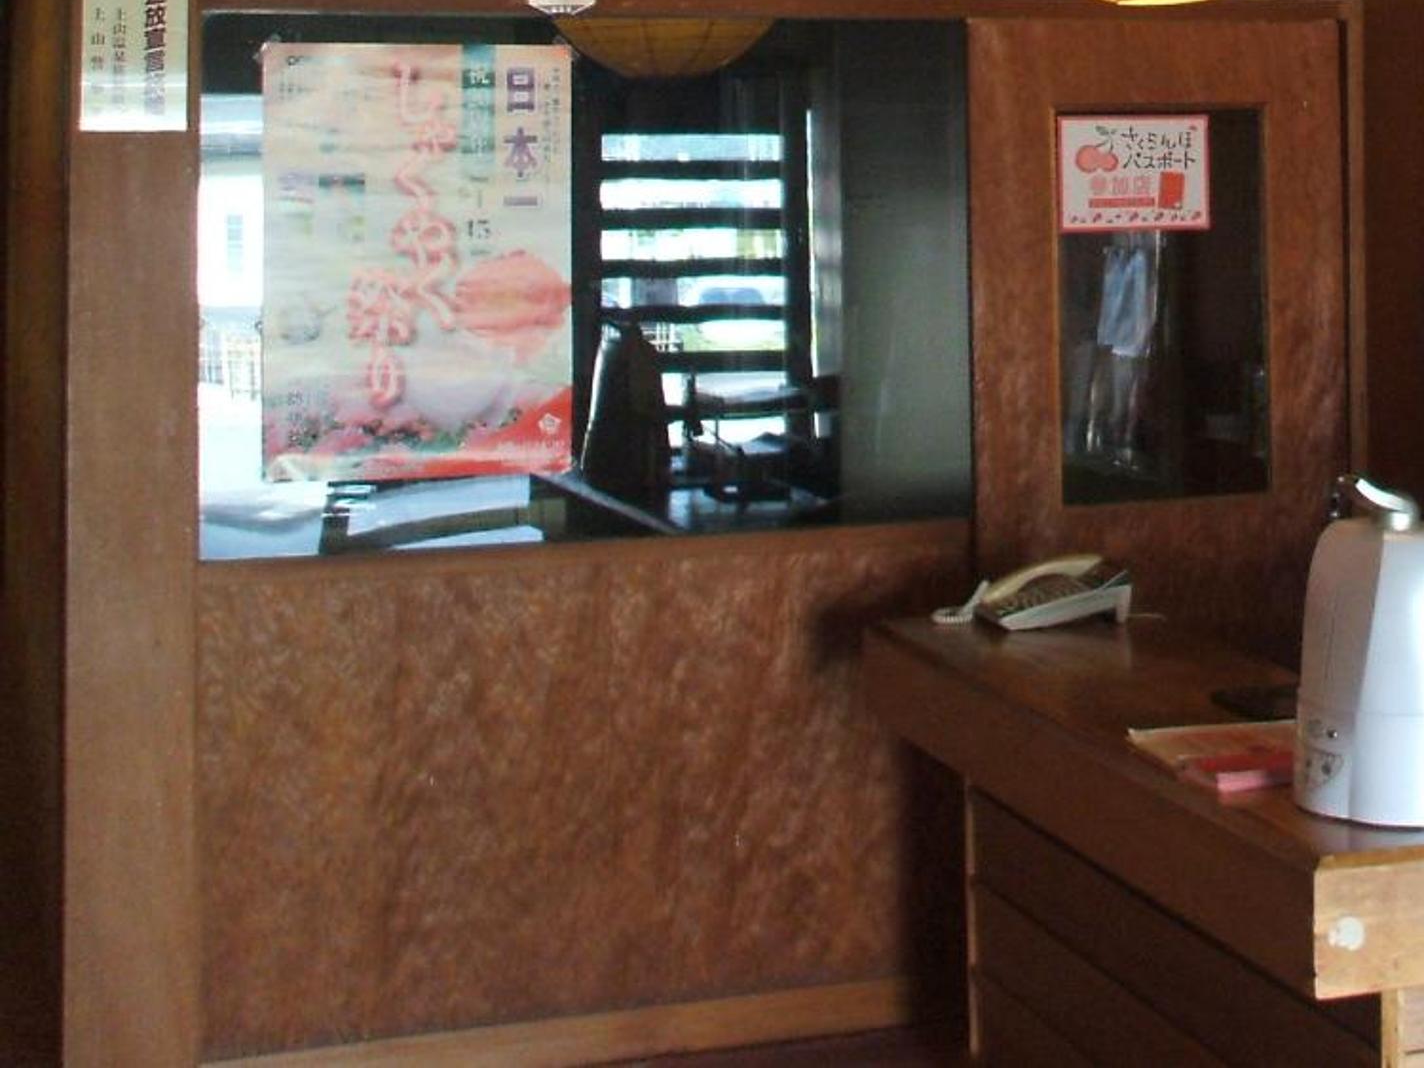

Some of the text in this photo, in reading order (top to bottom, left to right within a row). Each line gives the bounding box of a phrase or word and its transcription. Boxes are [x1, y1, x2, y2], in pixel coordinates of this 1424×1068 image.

[504, 67, 541, 208] 日本一
[1119, 124, 1198, 151] さくらんぼ
[1122, 150, 1197, 170] パスポート
